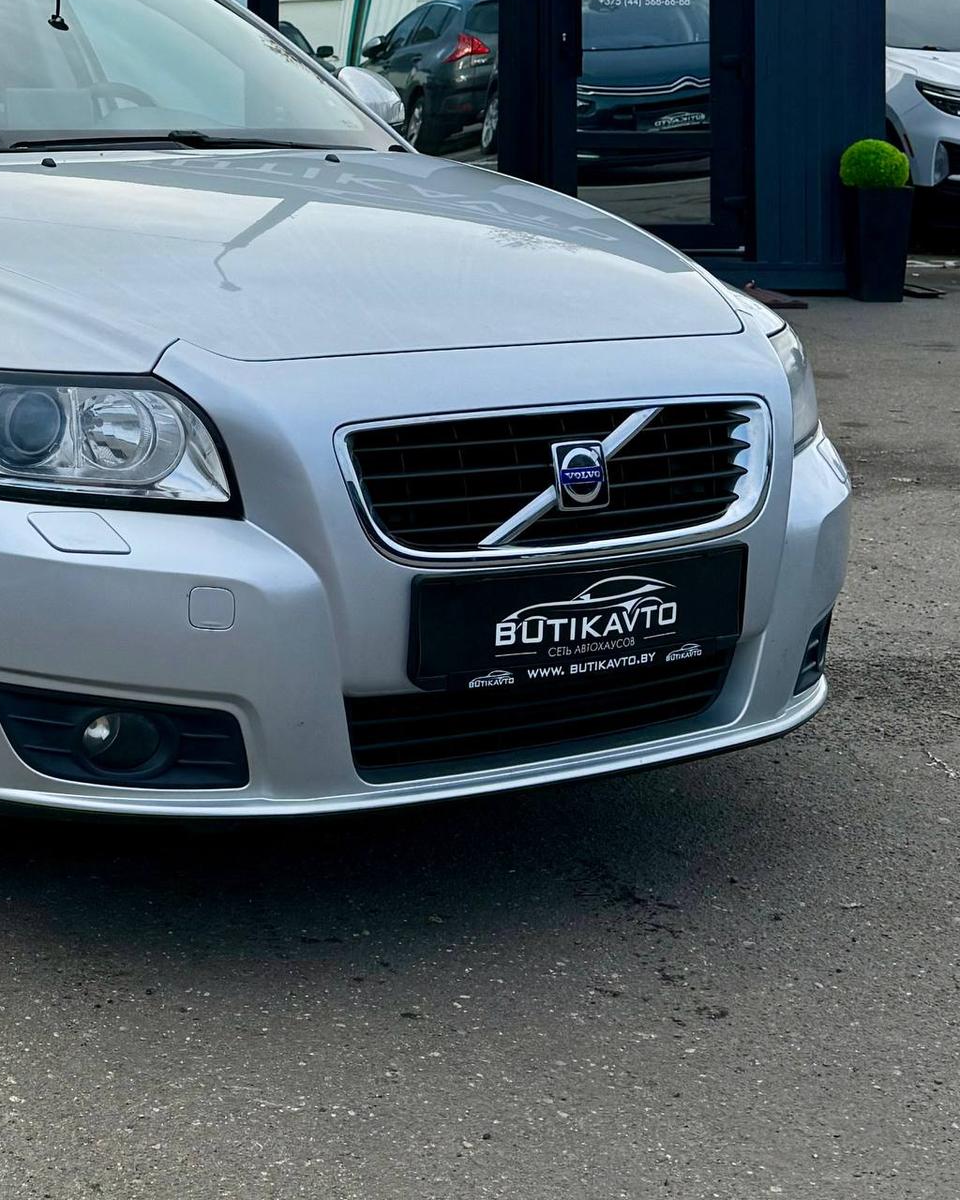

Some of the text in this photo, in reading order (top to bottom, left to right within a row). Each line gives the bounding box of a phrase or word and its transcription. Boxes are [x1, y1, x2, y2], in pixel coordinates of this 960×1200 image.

[564, 470, 601, 480] VOLVO
[495, 602, 678, 647] BUTIKAVTO
[548, 637, 636, 658] СЕТЬ АВТОХАУСОВ
[468, 677, 515, 689] BUTIKAVTO
